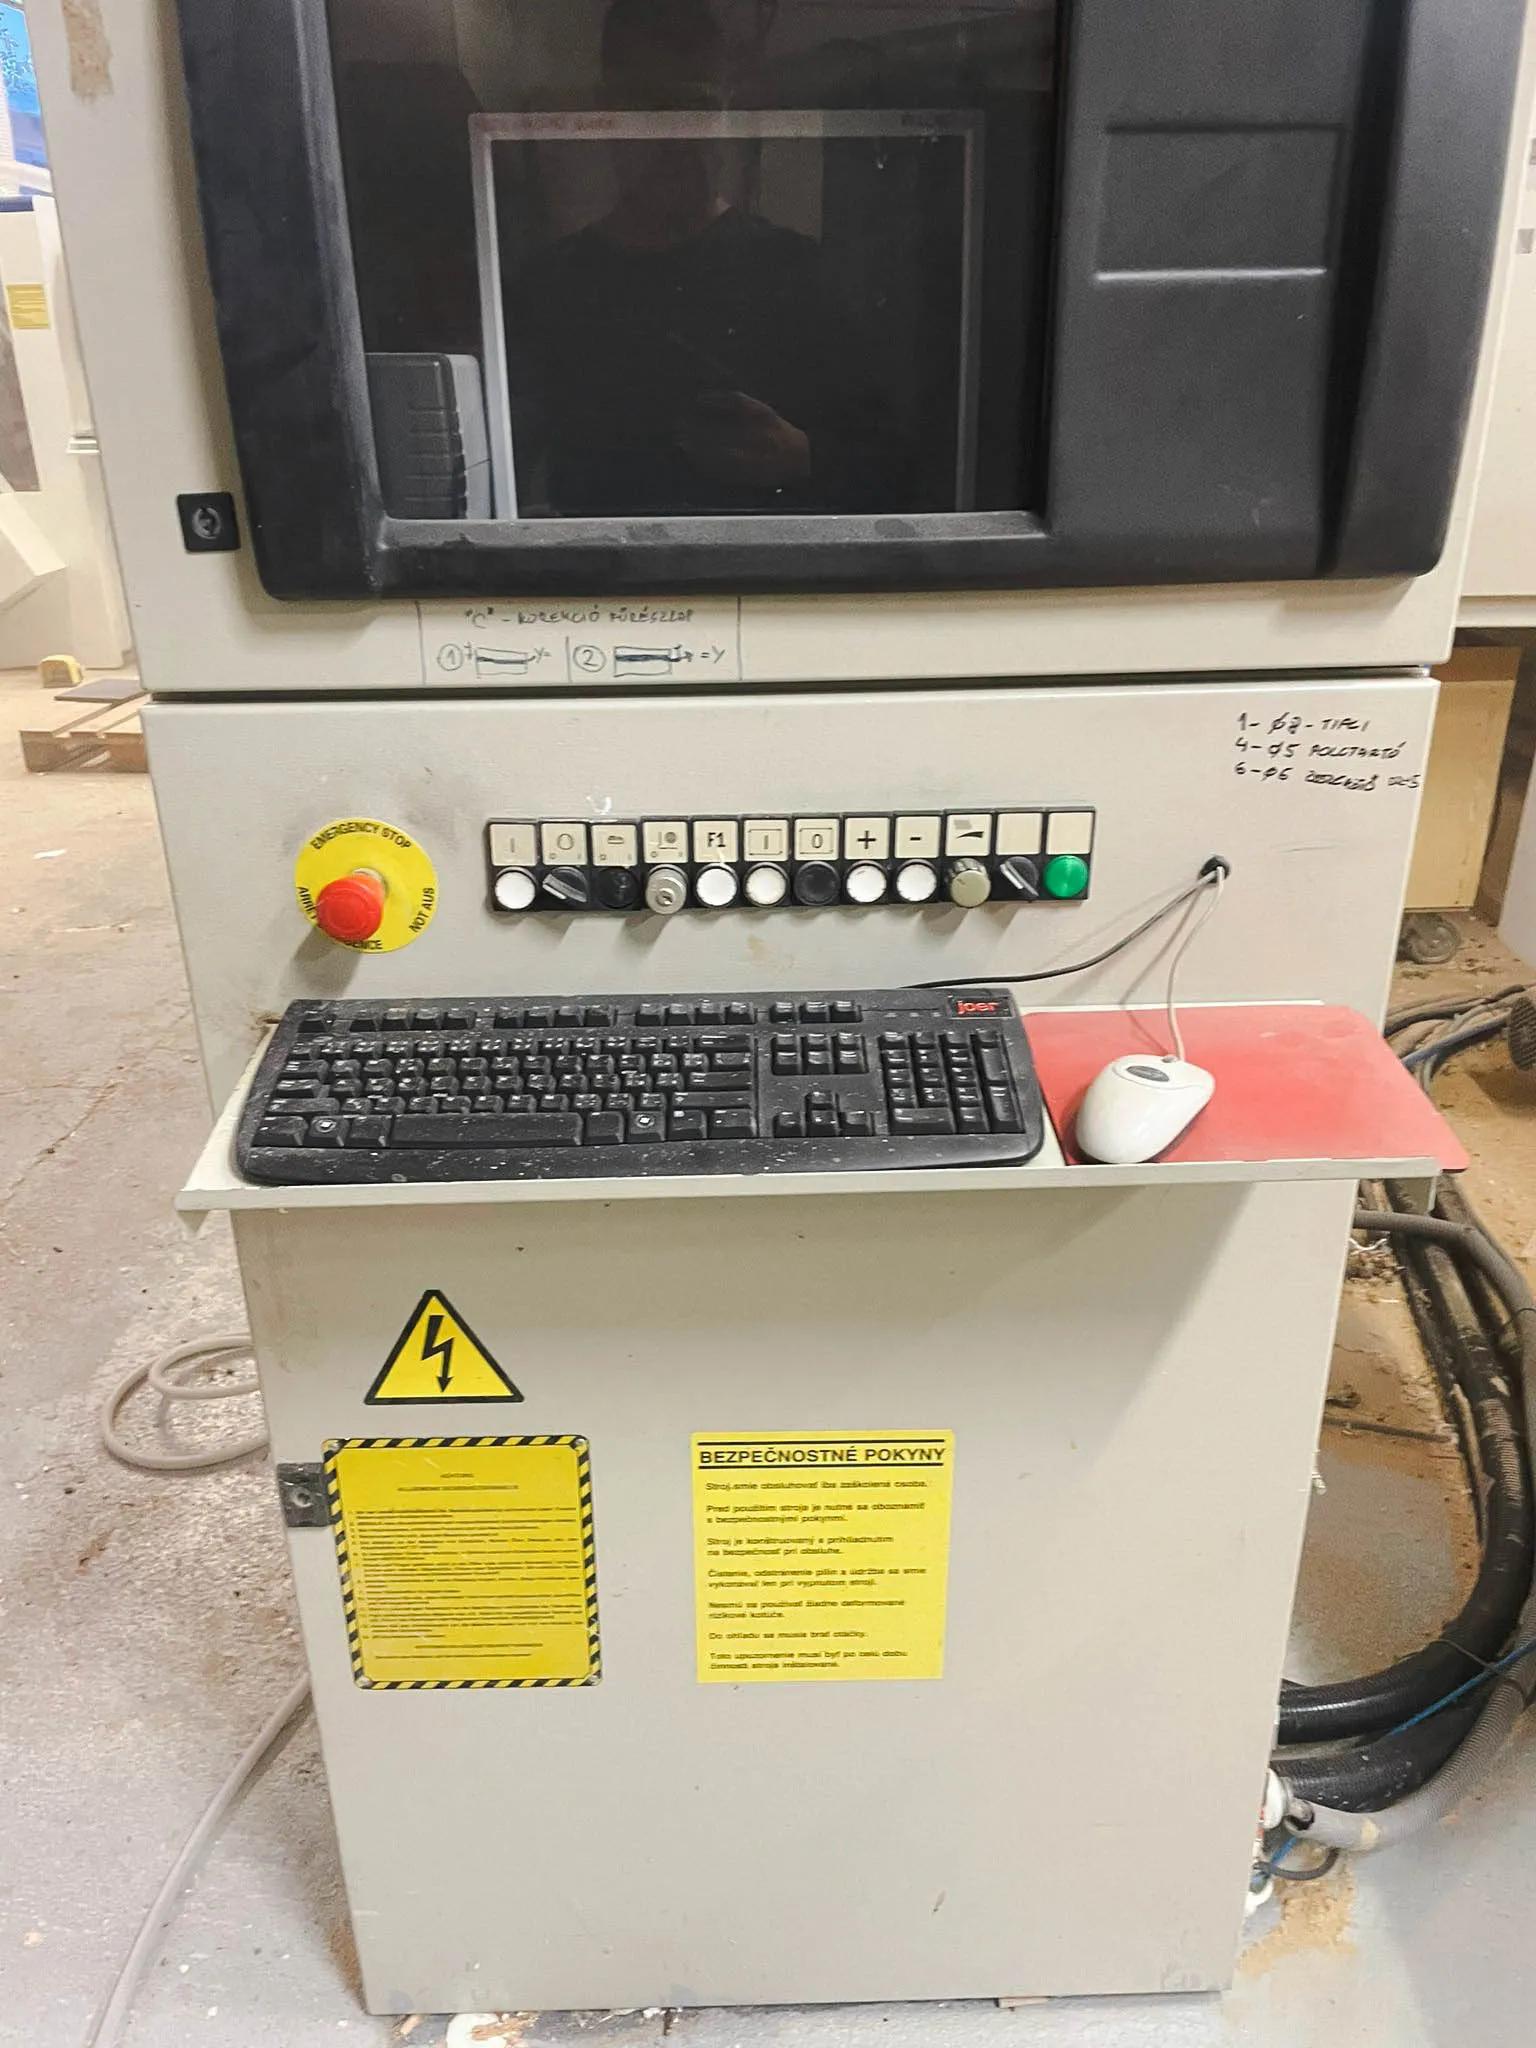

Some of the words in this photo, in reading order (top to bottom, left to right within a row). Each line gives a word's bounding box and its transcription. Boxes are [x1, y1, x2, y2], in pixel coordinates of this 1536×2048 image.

[310, 822, 379, 850] EMERGENCY
[381, 827, 412, 849] STOP
[707, 832, 727, 848] F1
[409, 911, 429, 934] NOT
[422, 887, 436, 911] AUS
[700, 1446, 857, 1464] BEZPEČNOSTNÉ
[864, 1448, 945, 1462] POKYNY
